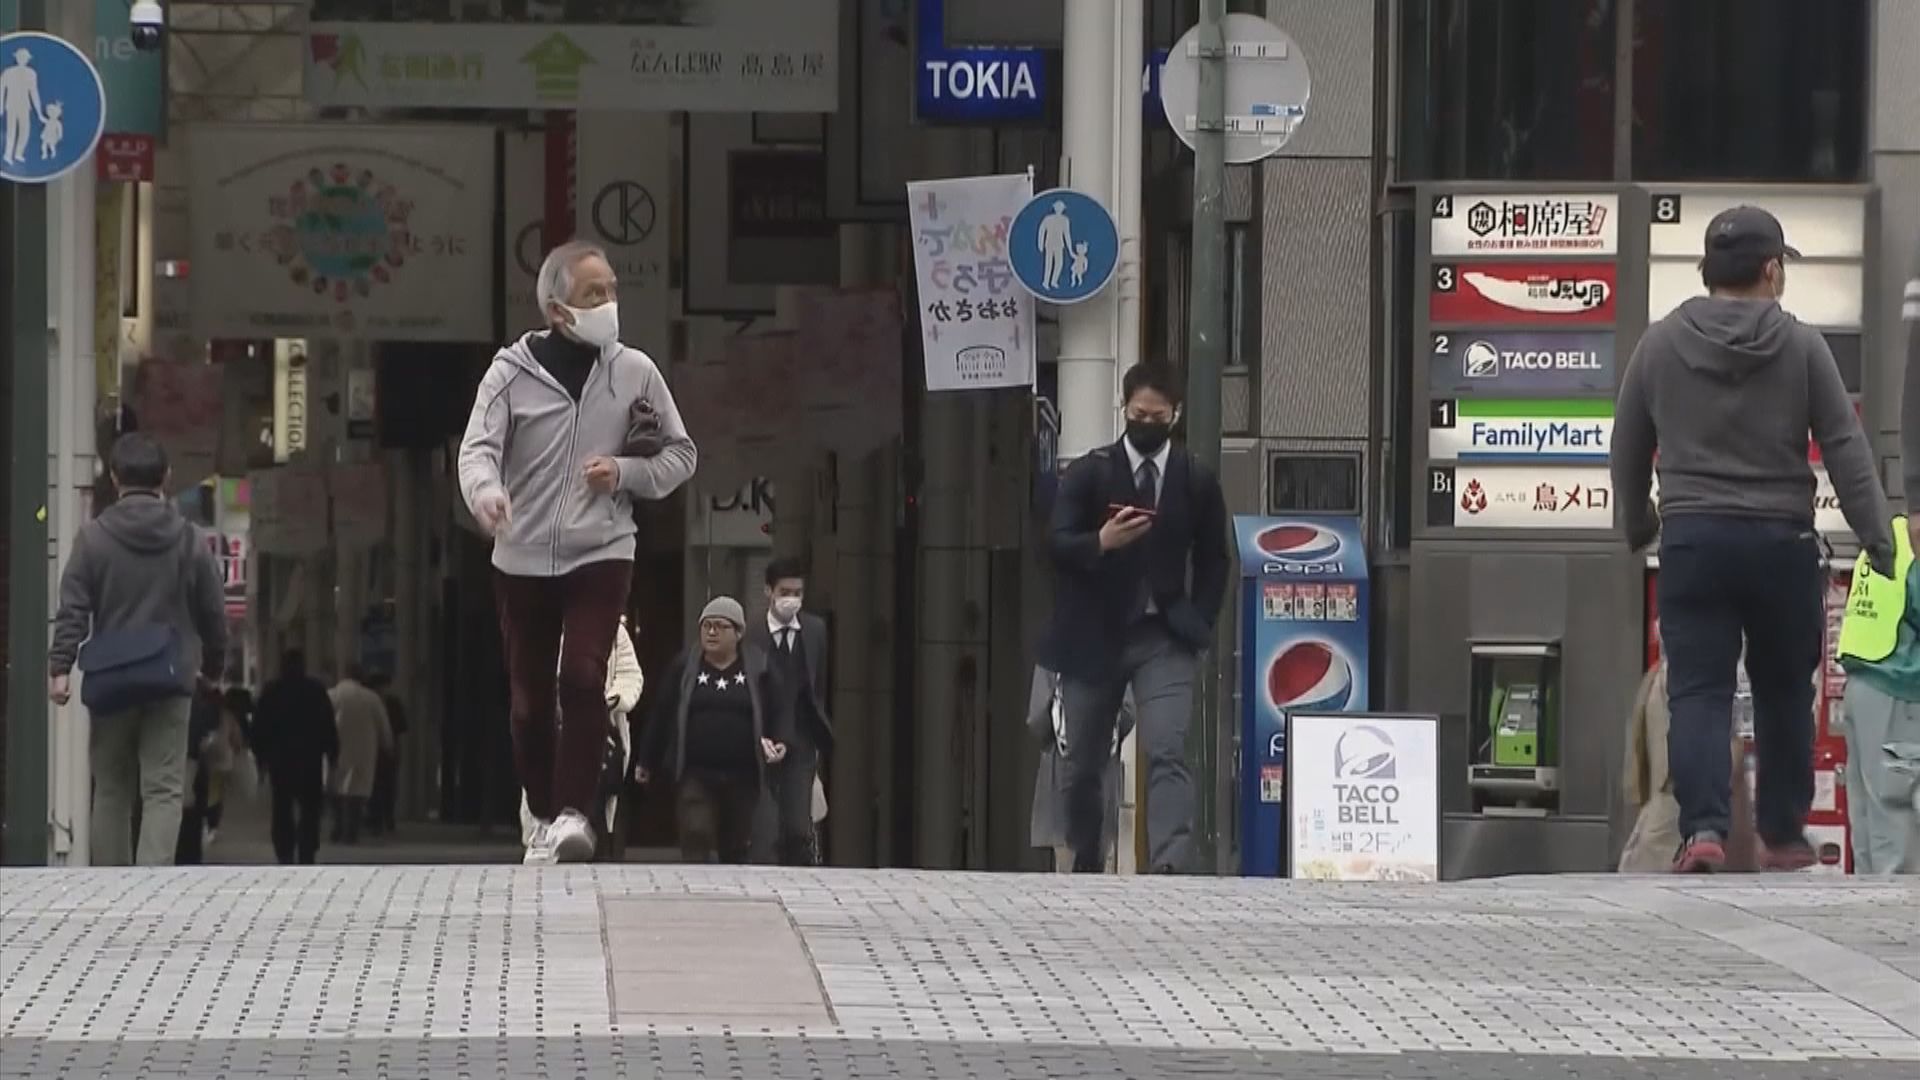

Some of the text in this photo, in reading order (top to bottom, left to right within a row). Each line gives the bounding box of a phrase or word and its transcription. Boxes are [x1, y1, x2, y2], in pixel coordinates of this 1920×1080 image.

[926, 60, 1037, 100] TOKIA
[1435, 197, 1450, 216] 4
[1656, 199, 1675, 221] 8
[1499, 200, 1593, 237] 相席屋
[1437, 267, 1453, 290] 3
[1435, 336, 1449, 353] 2
[1502, 352, 1602, 370] TACO BELL
[1439, 403, 1449, 426] 1
[1472, 422, 1603, 451] FamilyMart
[1533, 482, 1608, 511] 鳥メロ
[1263, 561, 1344, 575] pepsi
[1332, 784, 1400, 804] TACO
[1338, 806, 1400, 824] BELL
